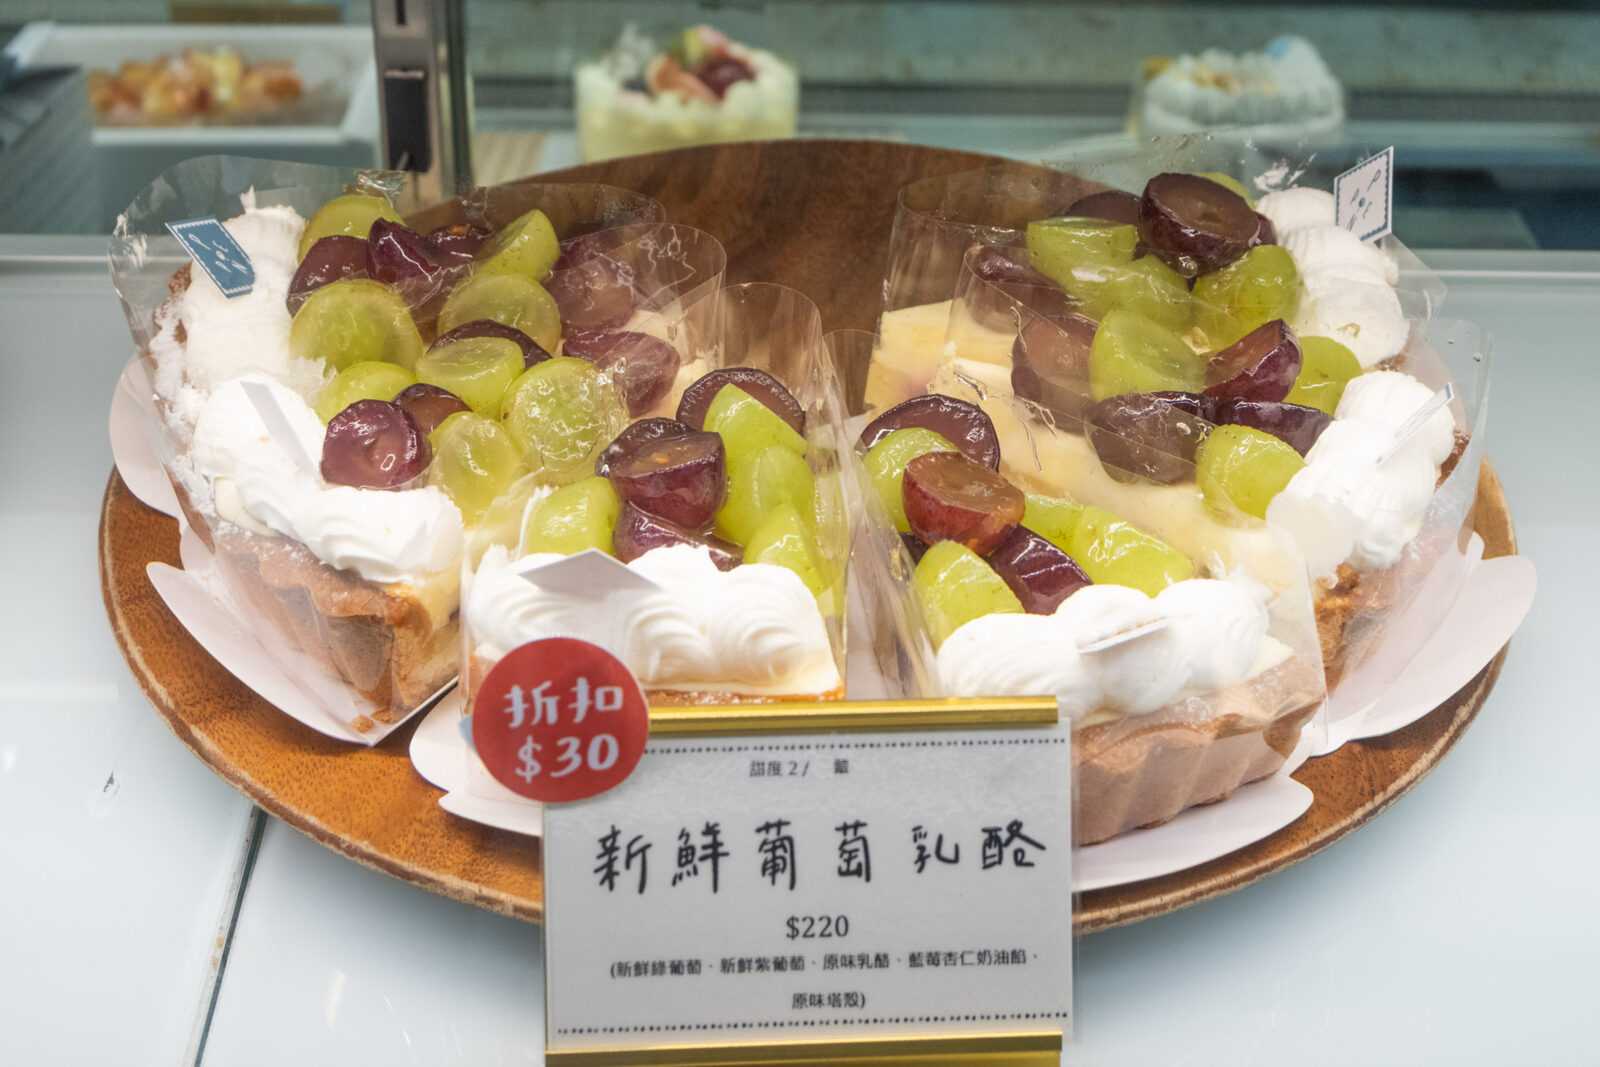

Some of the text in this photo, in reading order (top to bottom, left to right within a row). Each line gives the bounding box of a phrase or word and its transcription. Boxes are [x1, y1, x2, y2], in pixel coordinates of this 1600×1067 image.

[504, 677, 623, 728] 折扣
[515, 733, 619, 784] $30
[593, 819, 1047, 895] 新鮮葡萄乳酪
[786, 914, 850, 941] $220
